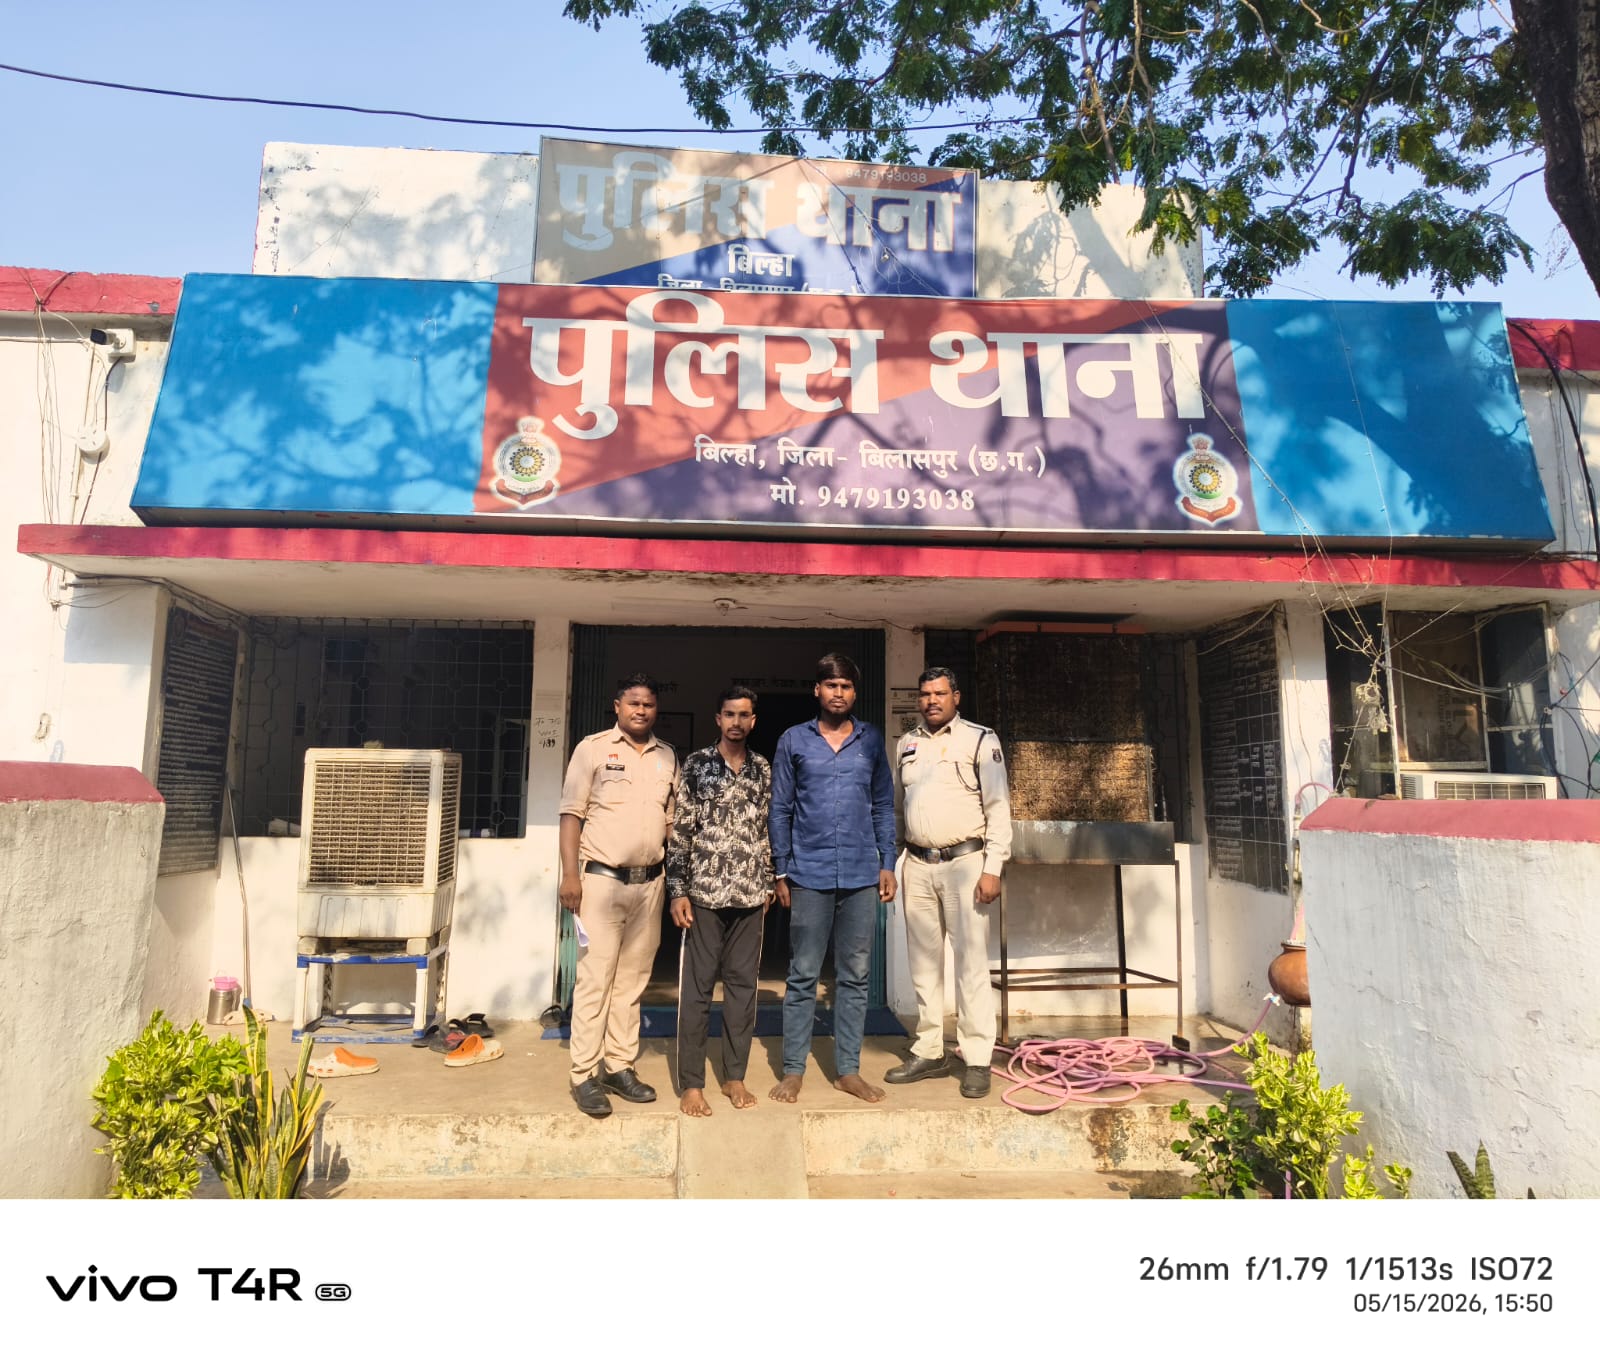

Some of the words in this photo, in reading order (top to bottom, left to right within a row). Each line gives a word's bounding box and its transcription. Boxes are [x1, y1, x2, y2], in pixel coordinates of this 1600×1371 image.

[845, 169, 928, 185] 9479193038
[556, 151, 775, 252] पुलिस
[796, 183, 963, 253] थाना
[727, 244, 796, 278] बिल्हा
[522, 290, 885, 440] पुलिस
[929, 330, 1206, 419] थाना
[694, 433, 766, 470] बिल्हा,
[858, 439, 959, 479] बिलासपुर
[968, 444, 1046, 479] (छ.ग.)
[769, 476, 805, 506] मो.
[817, 485, 976, 512] 9479193038
